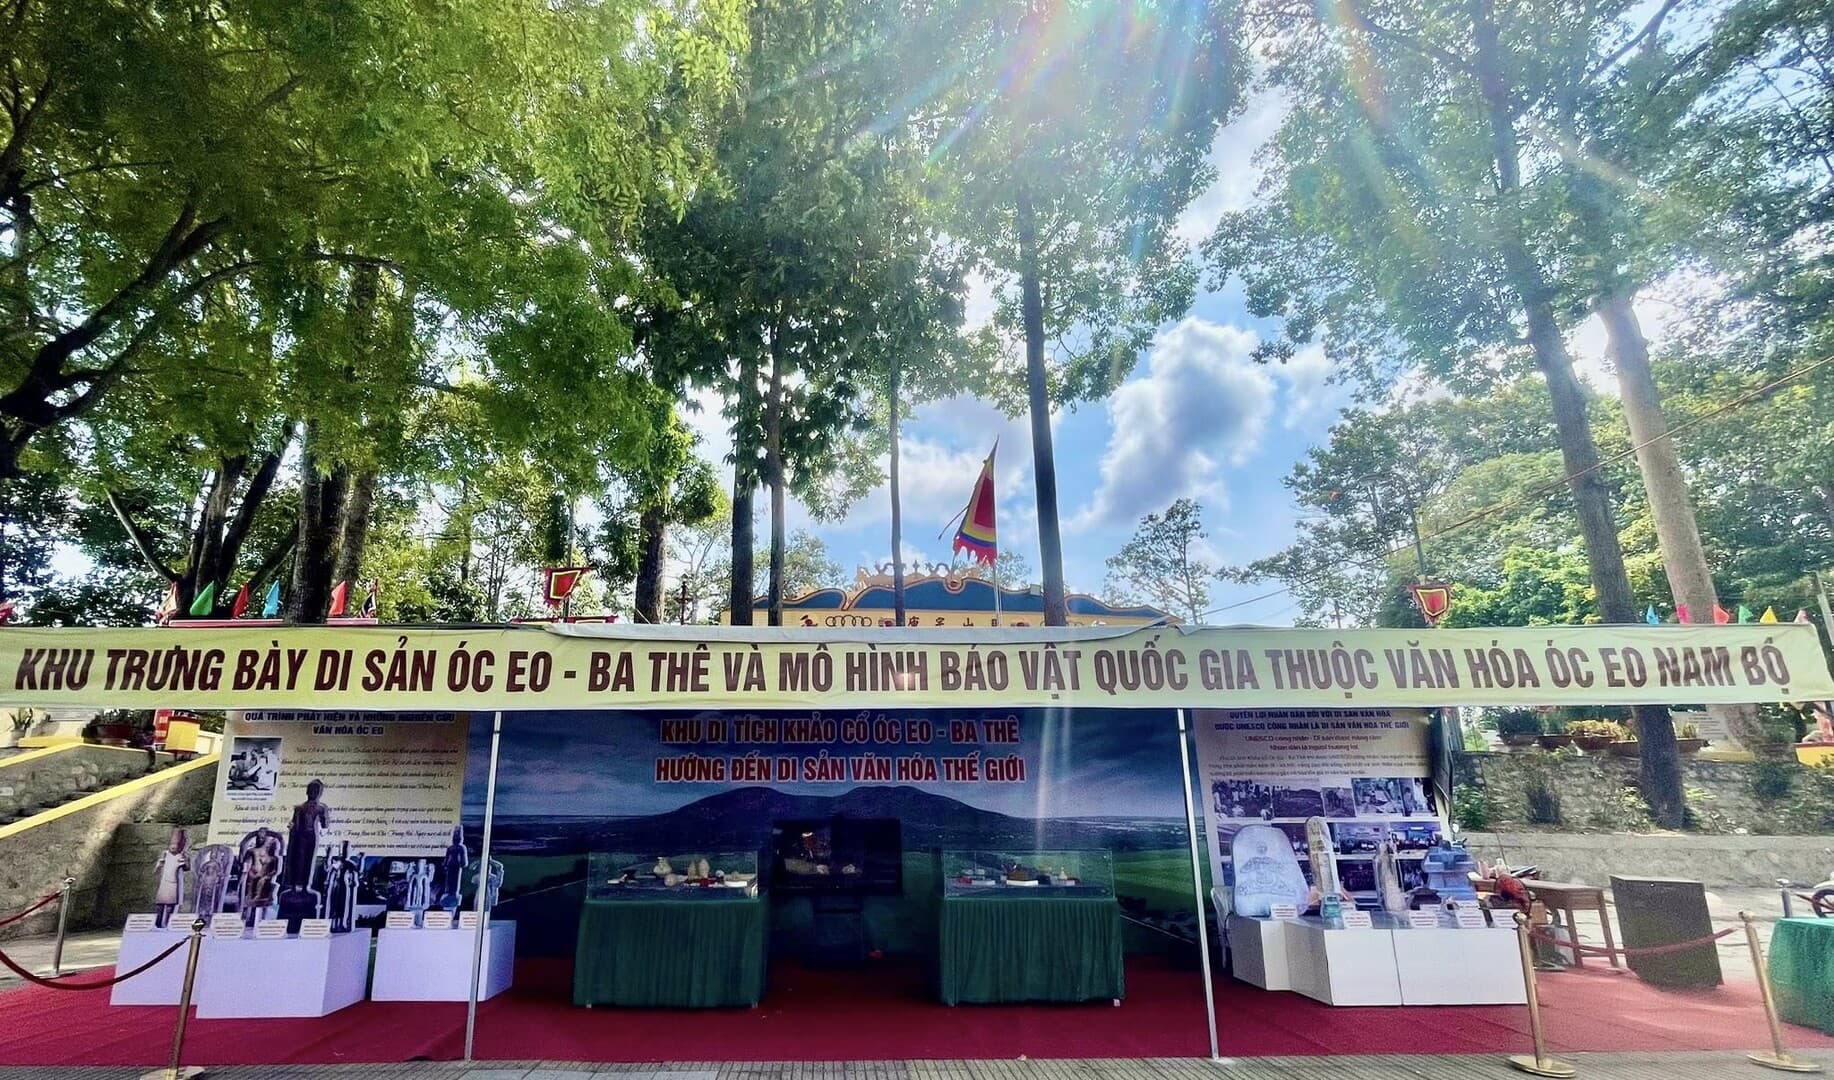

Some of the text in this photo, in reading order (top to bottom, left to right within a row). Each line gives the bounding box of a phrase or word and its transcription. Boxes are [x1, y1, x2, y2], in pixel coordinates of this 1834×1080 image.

[15, 648, 95, 690] KHU
[104, 645, 226, 690] TRƯNG
[232, 640, 308, 690] BÀY
[314, 649, 353, 691] DI
[361, 636, 437, 691] SẢN
[447, 641, 495, 692] ÓC
[506, 651, 552, 692] EO
[564, 670, 577, 679] -
[588, 651, 635, 692] BA
[648, 643, 710, 692] THÊ
[723, 643, 767, 692] VÀ
[779, 643, 834, 692] MÔ
[846, 643, 928, 692] HÌNH
[1019, 642, 1081, 700] VẬT
[1094, 634, 1188, 695] QUỐC
[1200, 648, 1260, 690] GIA
[1265, 640, 1379, 699] THUỘC
[1385, 640, 1460, 689] VĂN
[1464, 639, 1540, 688] HÓA
[1545, 639, 1594, 688] ÓC
[1600, 647, 1647, 688] EO
[1653, 646, 1736, 687] NAM
[1740, 636, 1791, 695] BỘ
[661, 718, 702, 743] KHU
[706, 718, 728, 743] DI
[734, 713, 778, 743] TÍCH
[782, 711, 837, 743] KHẢO
[841, 711, 869, 743] CỔ
[874, 715, 901, 743] ÓC
[906, 718, 931, 743] EO
[950, 719, 978, 743] BA
[983, 715, 1020, 743] THÊ
[655, 749, 1027, 782] HƯỚNG ĐẾN DI SẢN VĂN HÓA THẾ GIỚI
